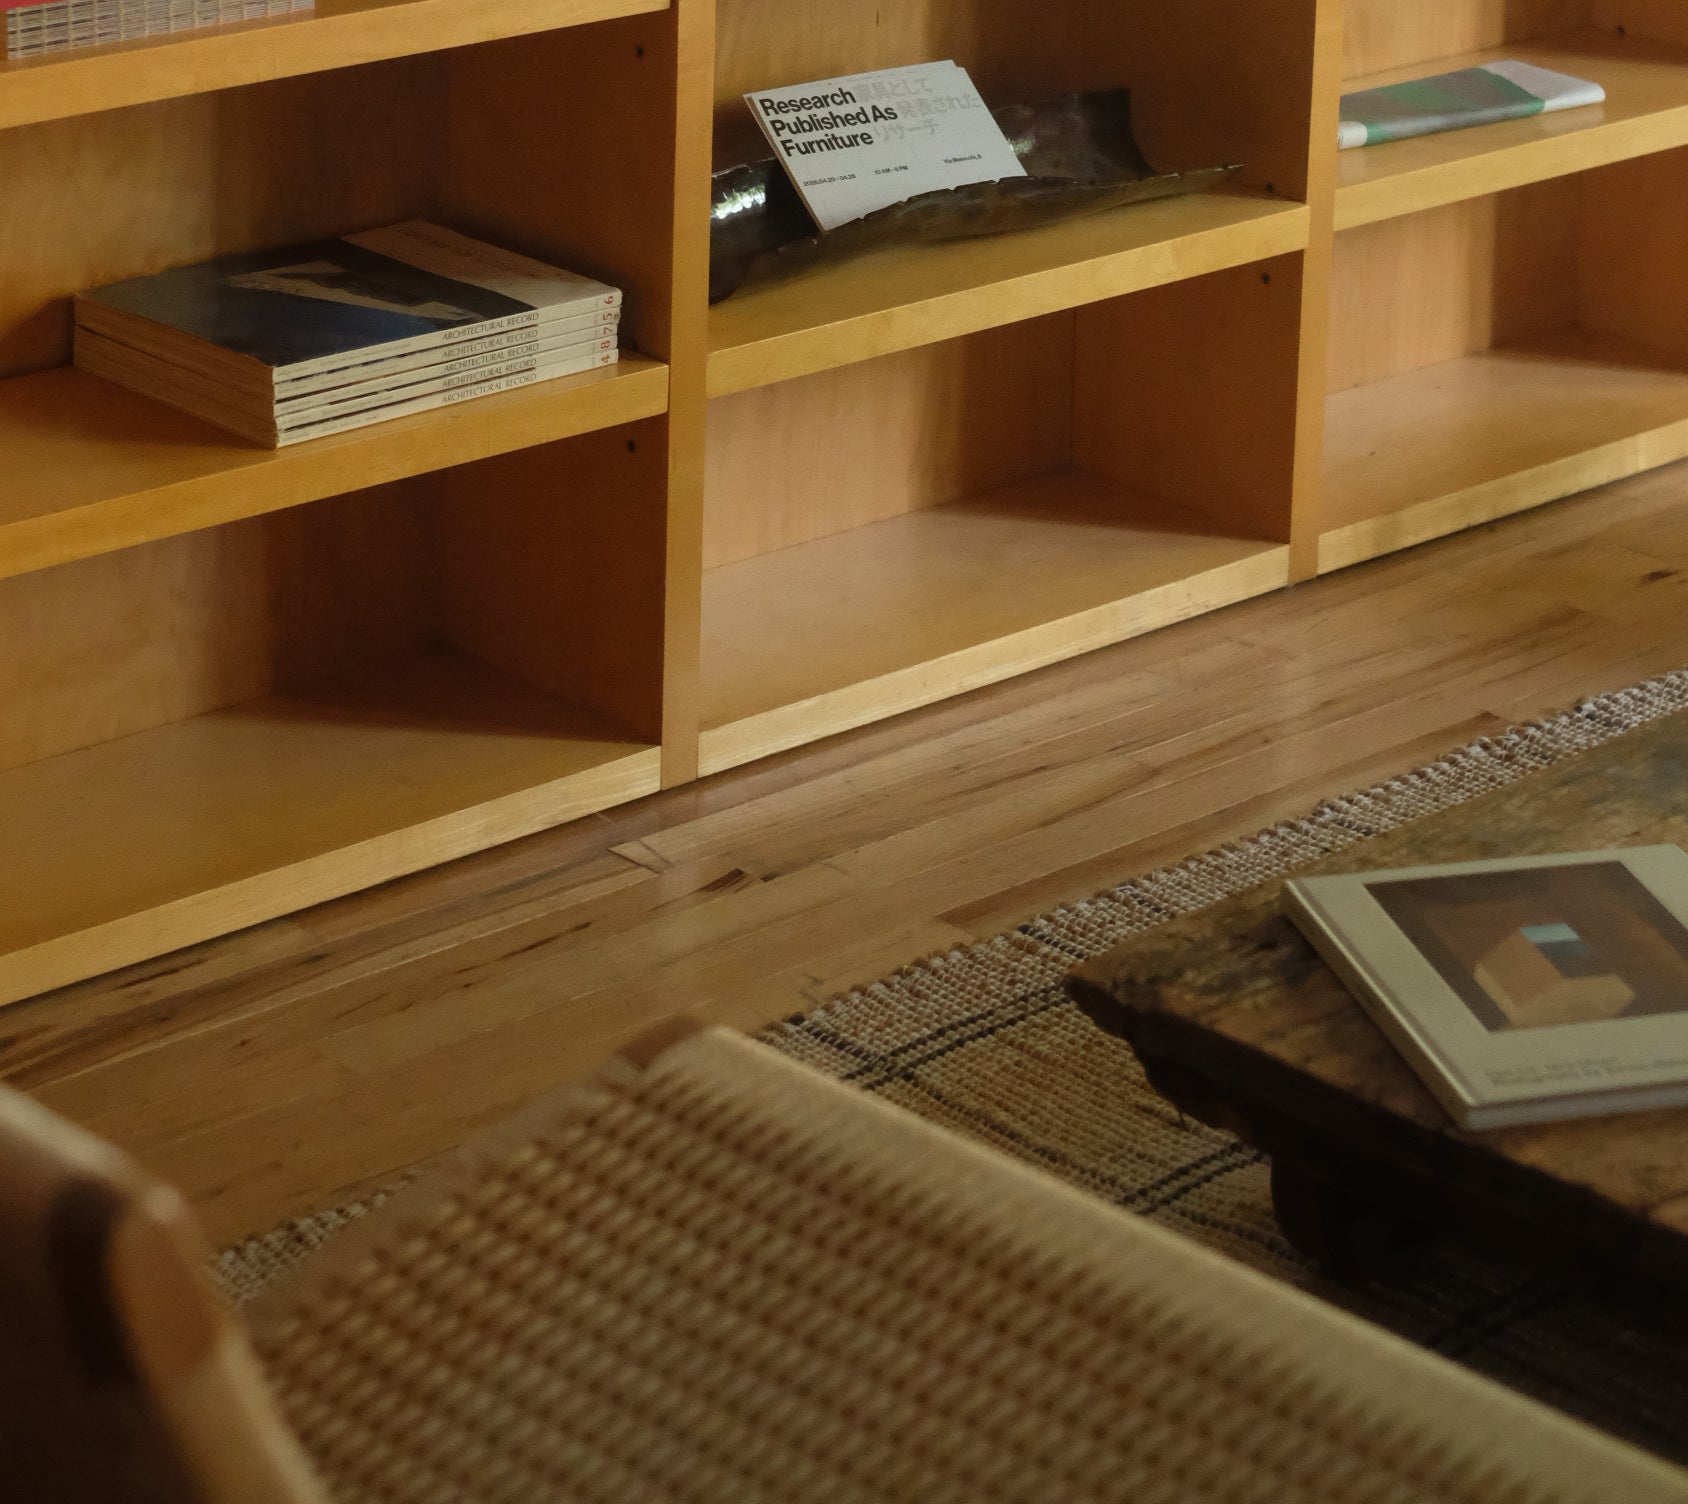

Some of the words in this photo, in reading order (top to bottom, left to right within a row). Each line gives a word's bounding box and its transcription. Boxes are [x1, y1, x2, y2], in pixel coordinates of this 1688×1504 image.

[758, 86, 857, 117] Research
[769, 105, 870, 138] Published
[872, 104, 898, 124] As
[780, 130, 875, 158] Furniture
[442, 321, 505, 341] ARCHITECTURAL
[507, 312, 539, 326] RECORD
[603, 327, 613, 335] 7
[441, 338, 505, 359] ARCHITECTURAL
[506, 329, 539, 343] RECORD
[443, 352, 505, 373] ARCHITECTURAL
[507, 343, 539, 358] RECORD
[600, 340, 611, 350] 8
[441, 367, 502, 389] ARCHITECTURAL
[505, 358, 537, 372] RECORD
[441, 382, 502, 404] ARCHITECTURAL
[505, 373, 537, 388] RECORD
